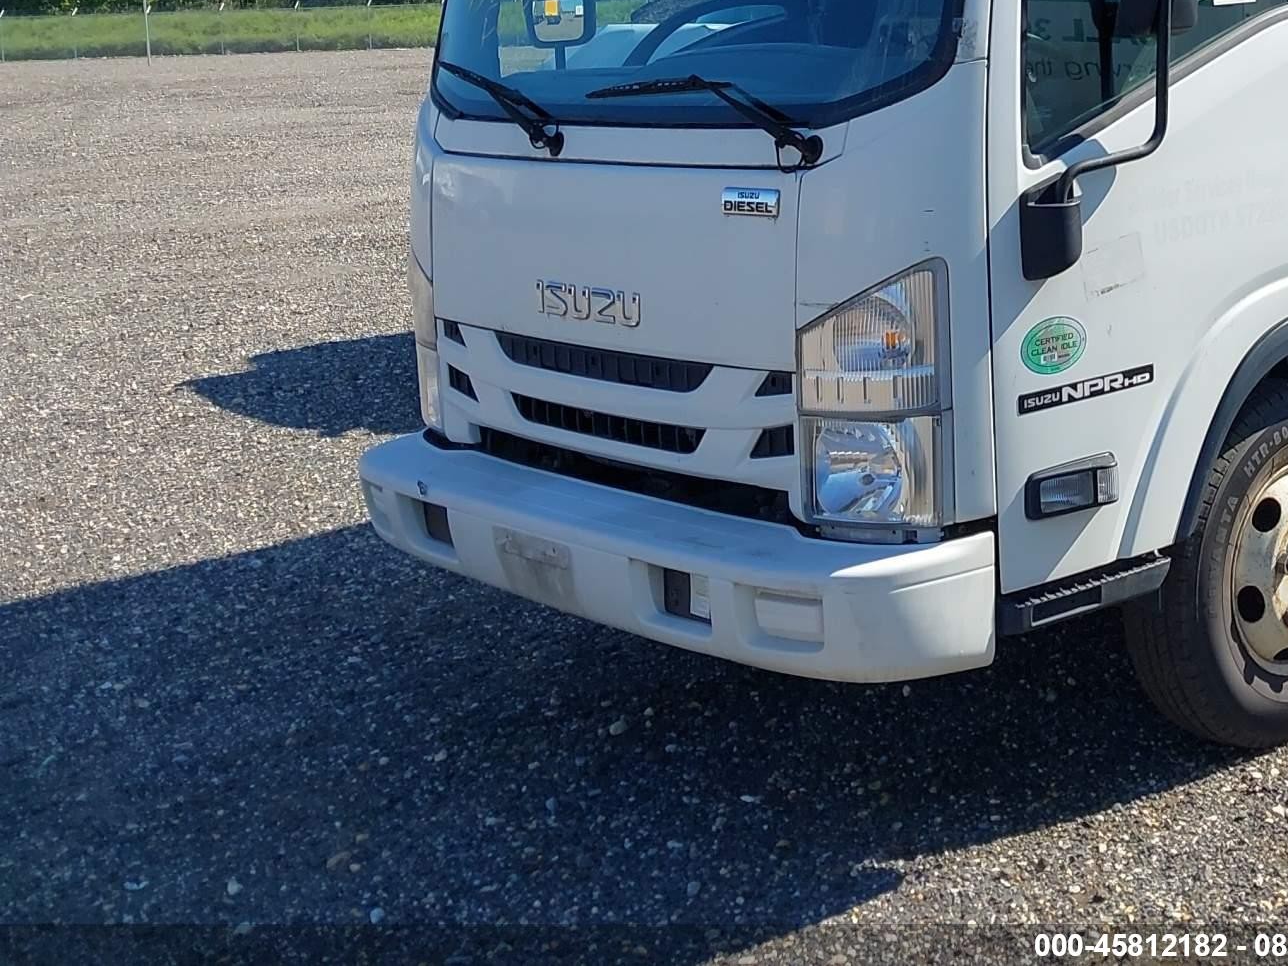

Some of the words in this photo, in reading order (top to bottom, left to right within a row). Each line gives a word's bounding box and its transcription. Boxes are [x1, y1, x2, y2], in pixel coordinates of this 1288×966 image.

[737, 191, 760, 200] ISUZU
[723, 200, 773, 214] DIESEL
[536, 279, 641, 328] ISUZU
[1034, 332, 1074, 347] CERTIFIED
[1031, 345, 1058, 357] CLEAN
[1060, 340, 1078, 350] IDLE
[1024, 391, 1060, 409] ISUZU
[1061, 374, 1124, 403] NPR
[1124, 372, 1151, 387] HD
